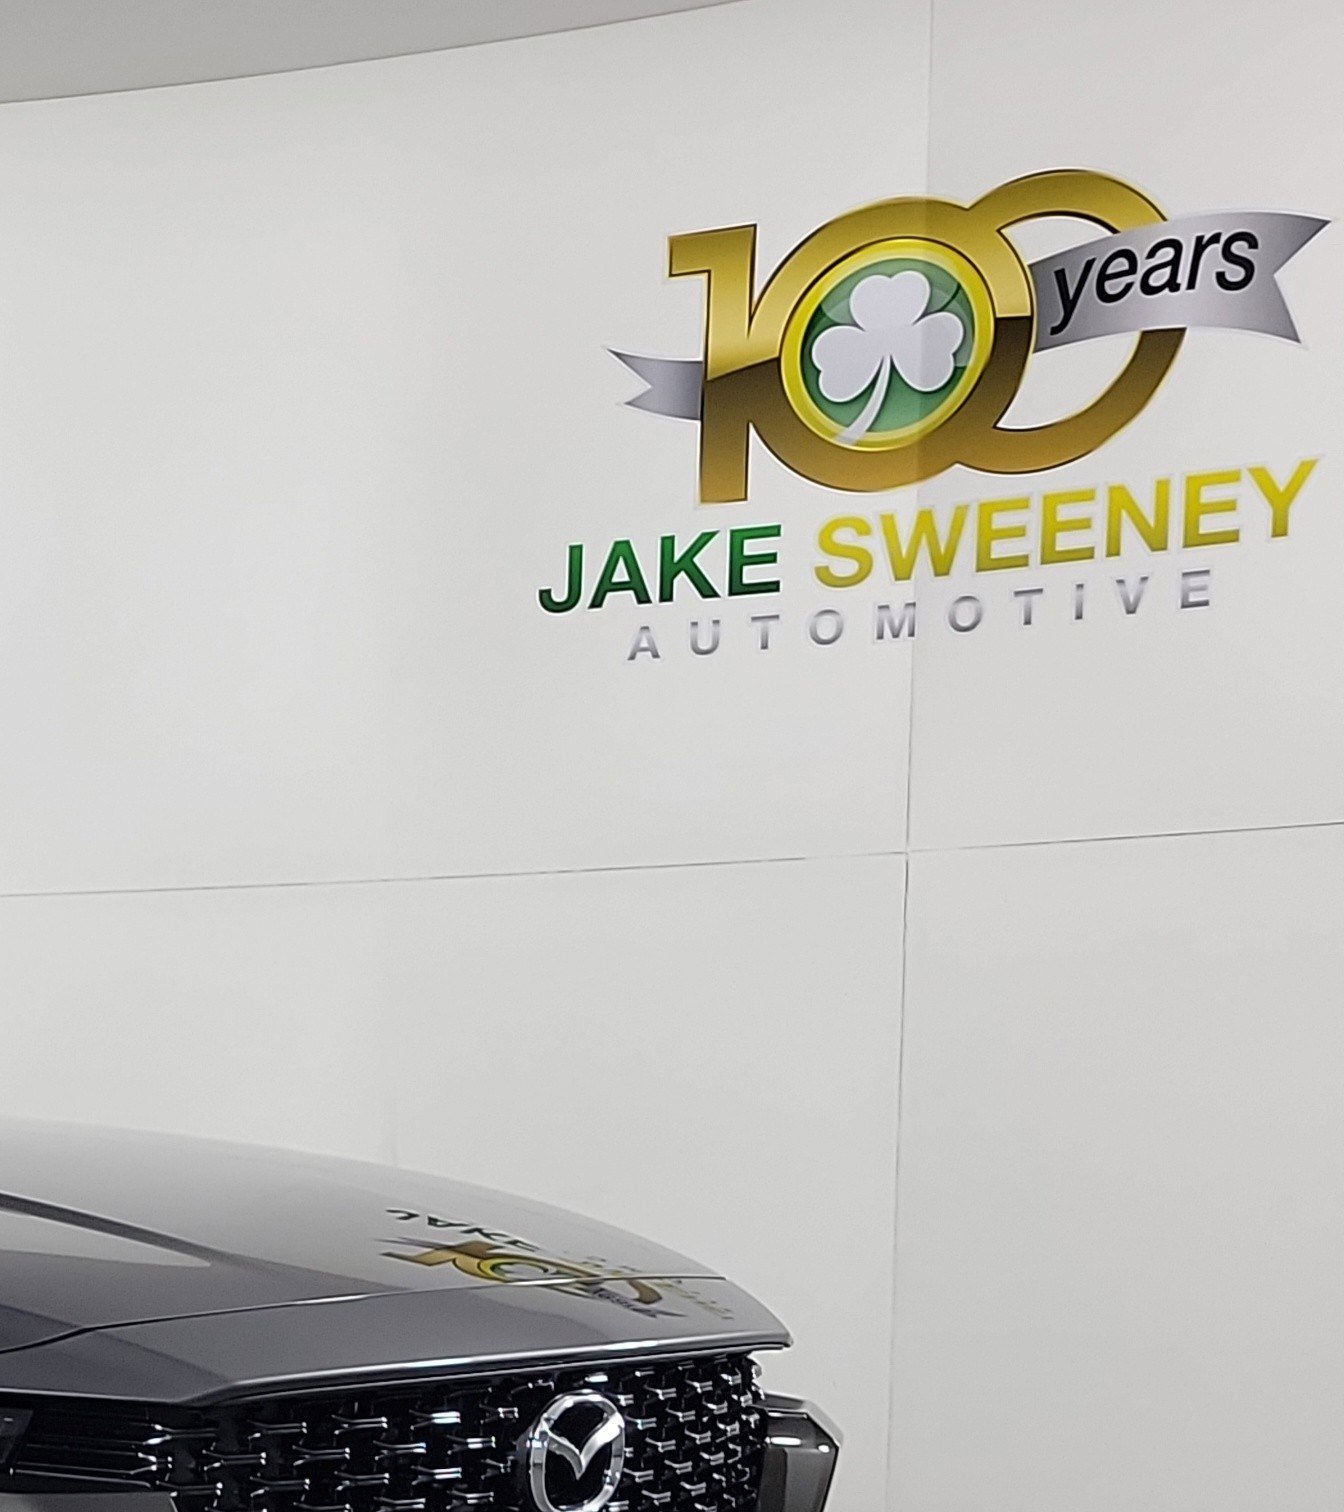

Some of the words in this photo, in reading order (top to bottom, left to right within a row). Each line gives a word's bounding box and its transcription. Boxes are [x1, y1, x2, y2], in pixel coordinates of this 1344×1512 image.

[1048, 230, 1260, 337] years
[537, 523, 783, 614] JAKE
[813, 458, 1319, 590] SWEENEY
[625, 568, 1212, 663] AUTOMOTIVE
